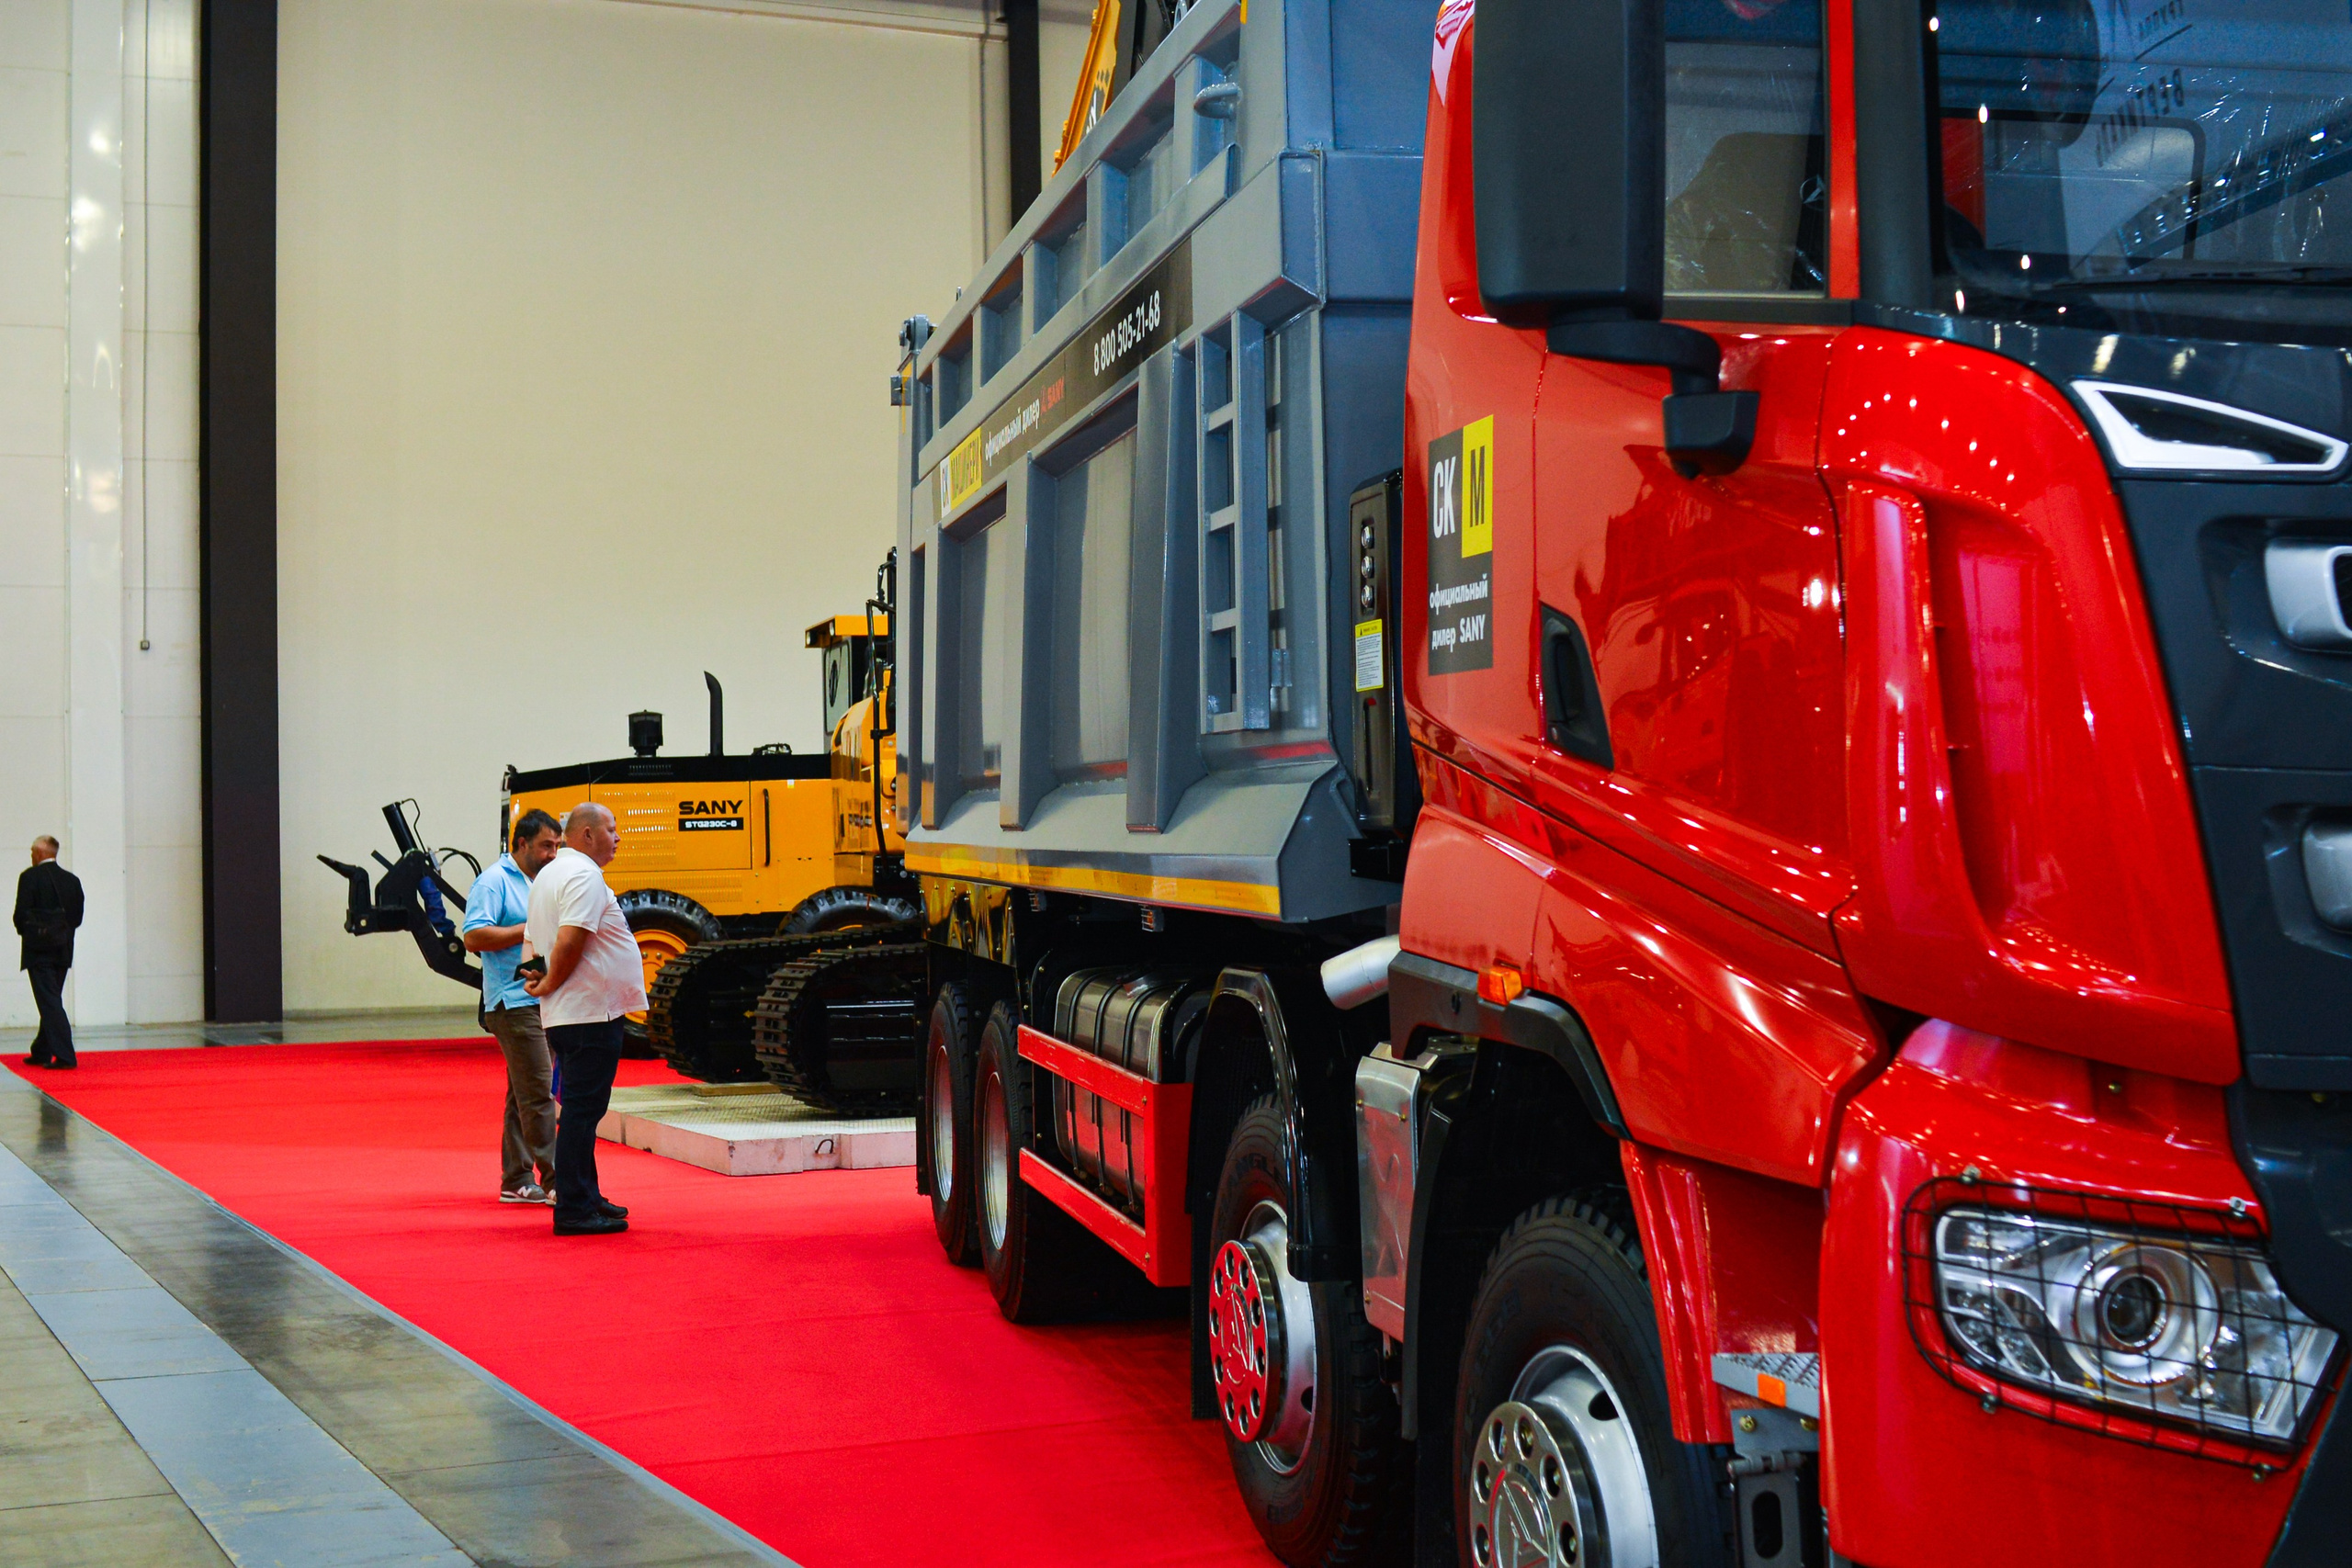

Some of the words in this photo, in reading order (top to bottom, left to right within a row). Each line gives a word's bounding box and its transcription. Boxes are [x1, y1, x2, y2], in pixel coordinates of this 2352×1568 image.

[1093, 342, 1100, 377] 8
[1101, 328, 1116, 371] 800
[1117, 289, 1160, 357] 505-21-68
[1022, 398, 1040, 434] дилер
[1433, 456, 1457, 538] СК
[1470, 446, 1486, 528] М
[1430, 574, 1488, 615] официальный
[1431, 626, 1456, 653] дилер
[1459, 615, 1486, 644] SANY
[678, 800, 744, 816] SANY
